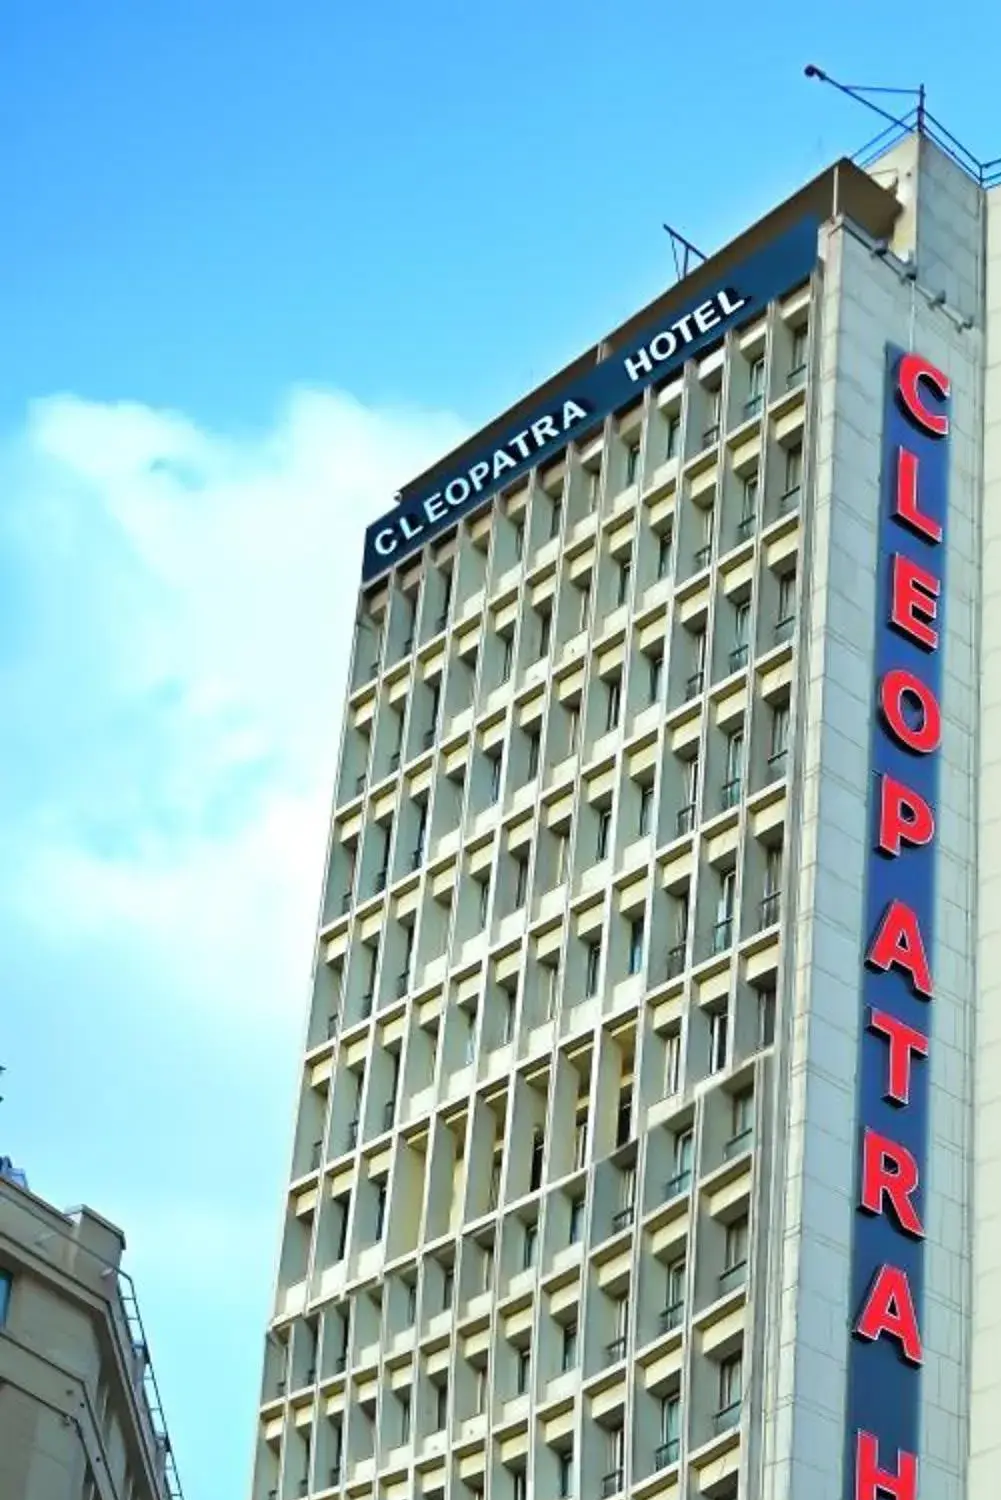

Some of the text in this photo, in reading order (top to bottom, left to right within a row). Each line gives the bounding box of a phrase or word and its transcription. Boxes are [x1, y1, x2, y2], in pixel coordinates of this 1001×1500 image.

[373, 287, 746, 556] CLEOPATRA HOTEL
[859, 353, 952, 1366] CLEOPATRA
